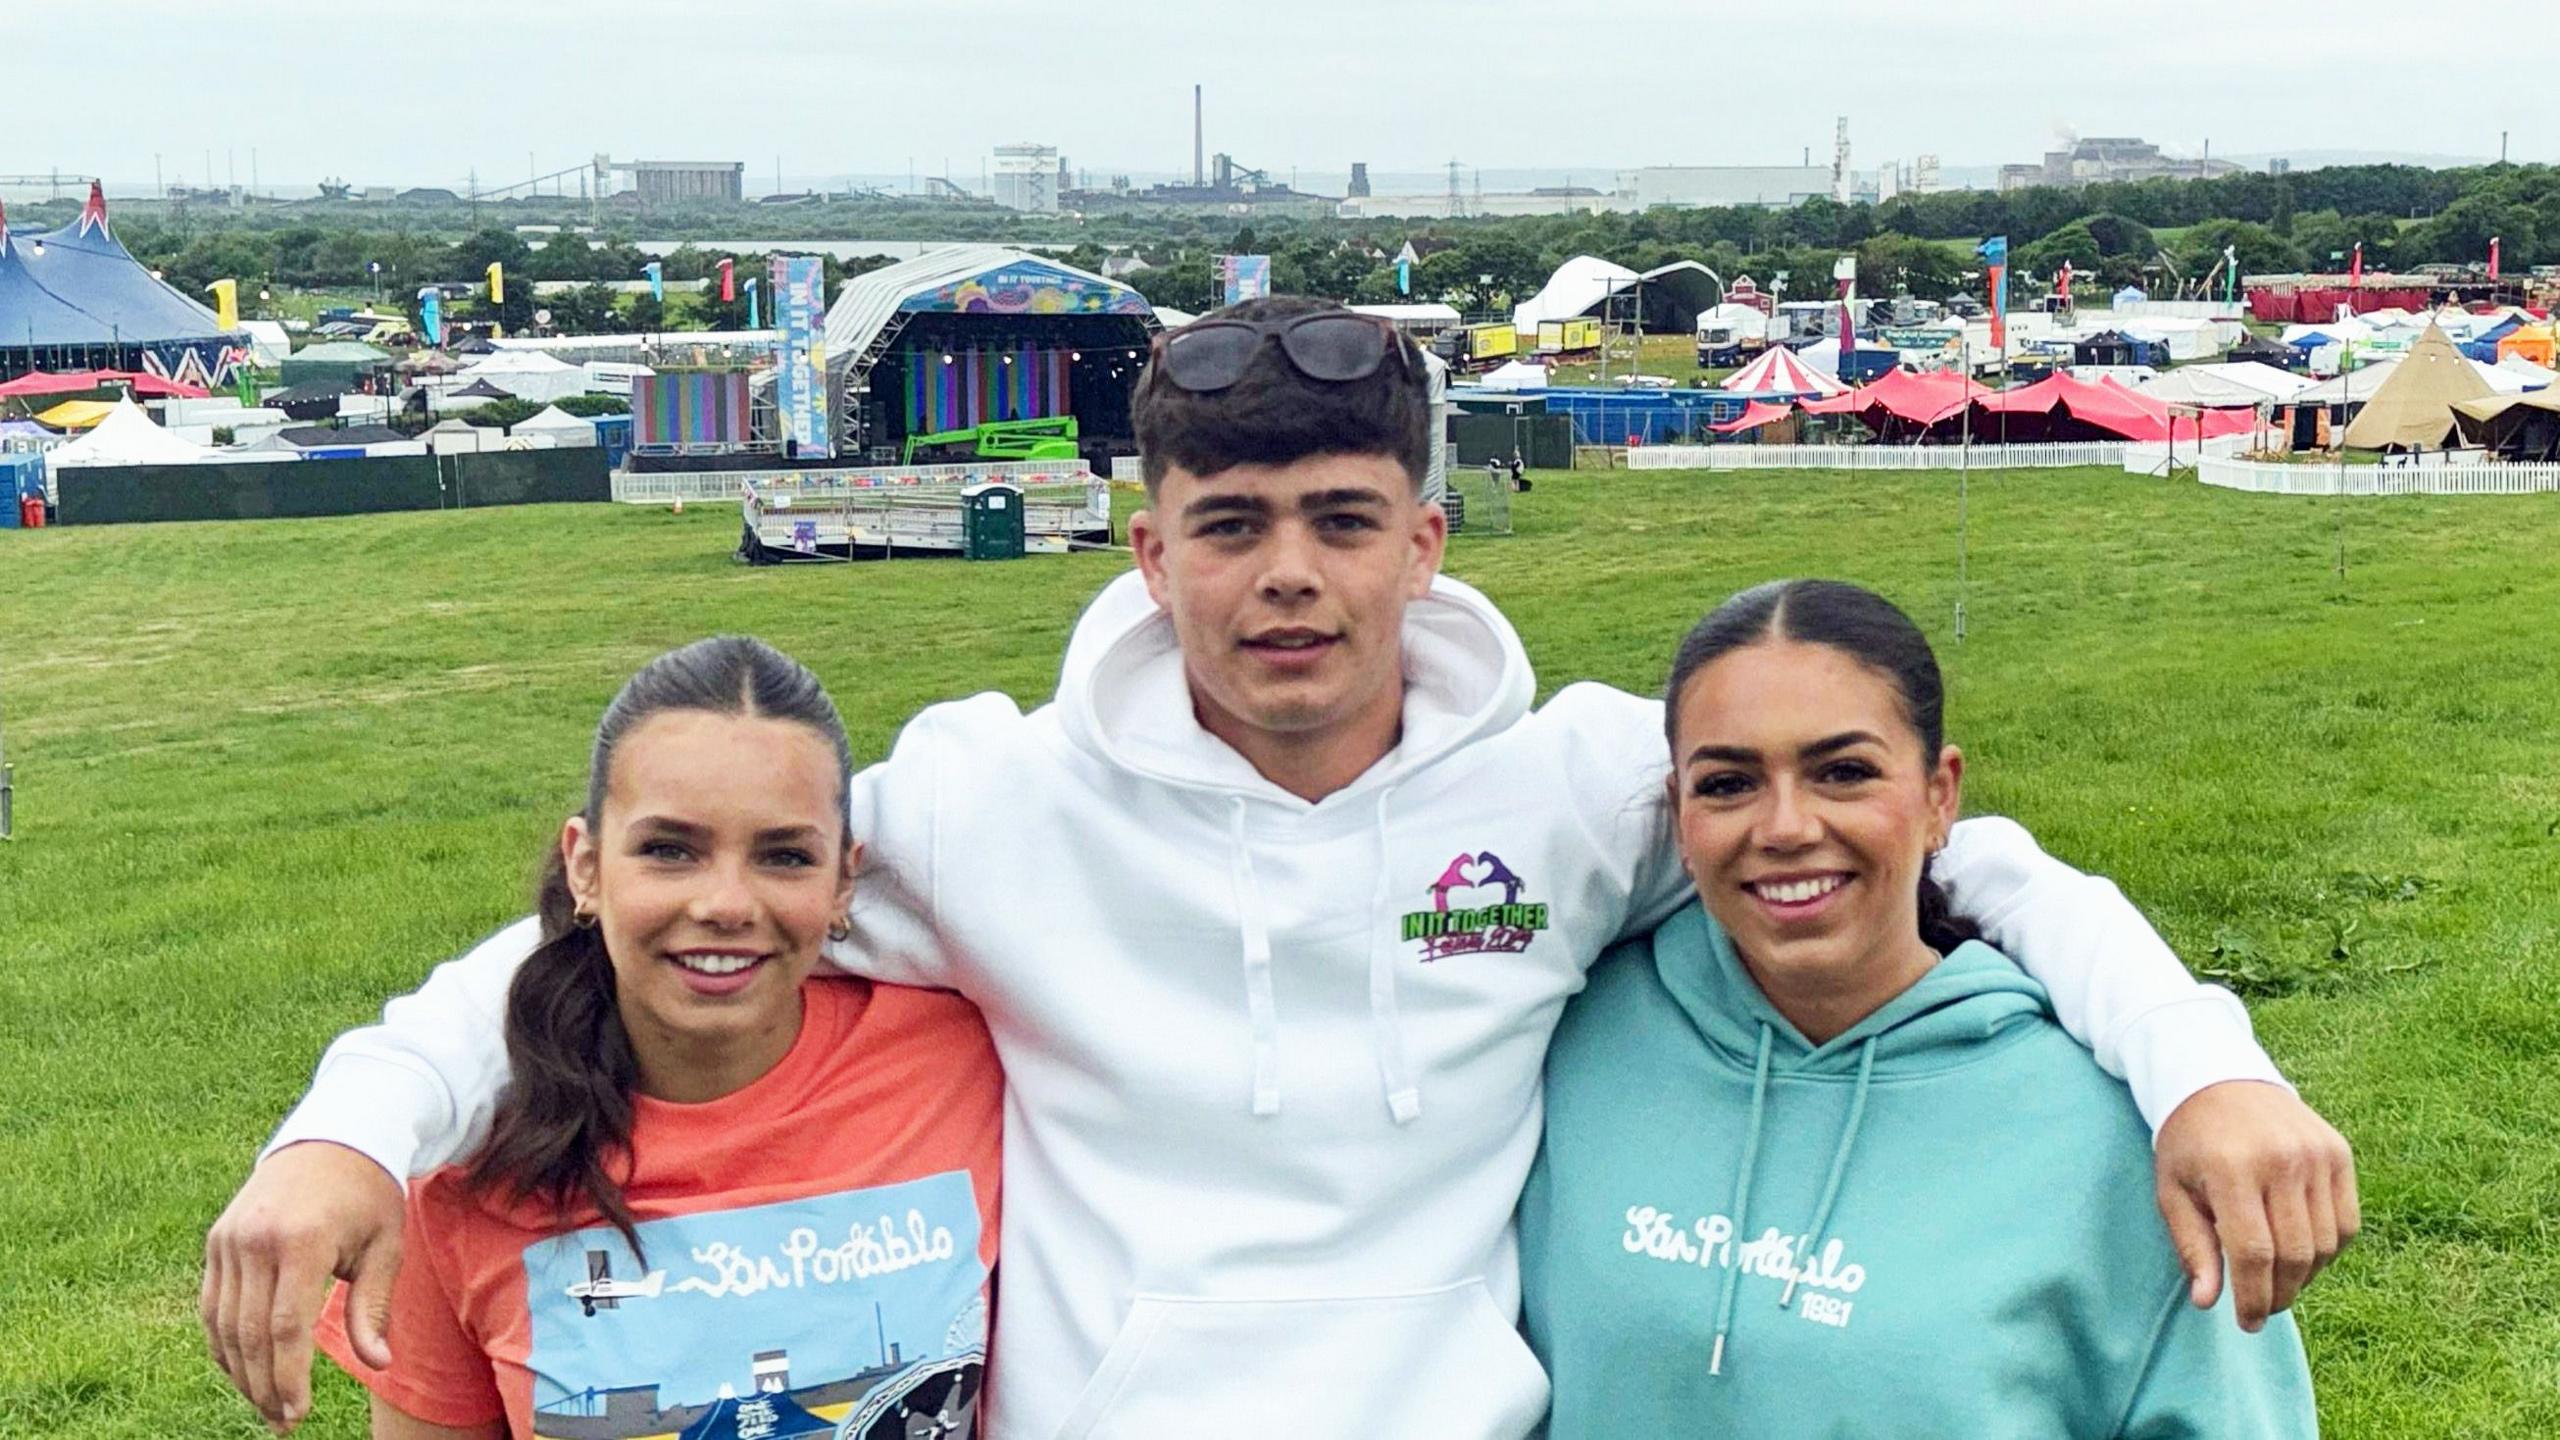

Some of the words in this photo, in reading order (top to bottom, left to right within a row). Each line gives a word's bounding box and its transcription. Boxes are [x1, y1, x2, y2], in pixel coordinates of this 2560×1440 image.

[789, 282, 807, 308] IN
[790, 310, 809, 331] IT
[1402, 913, 1425, 942] IN
[1449, 902, 1551, 933] TOGETHER
